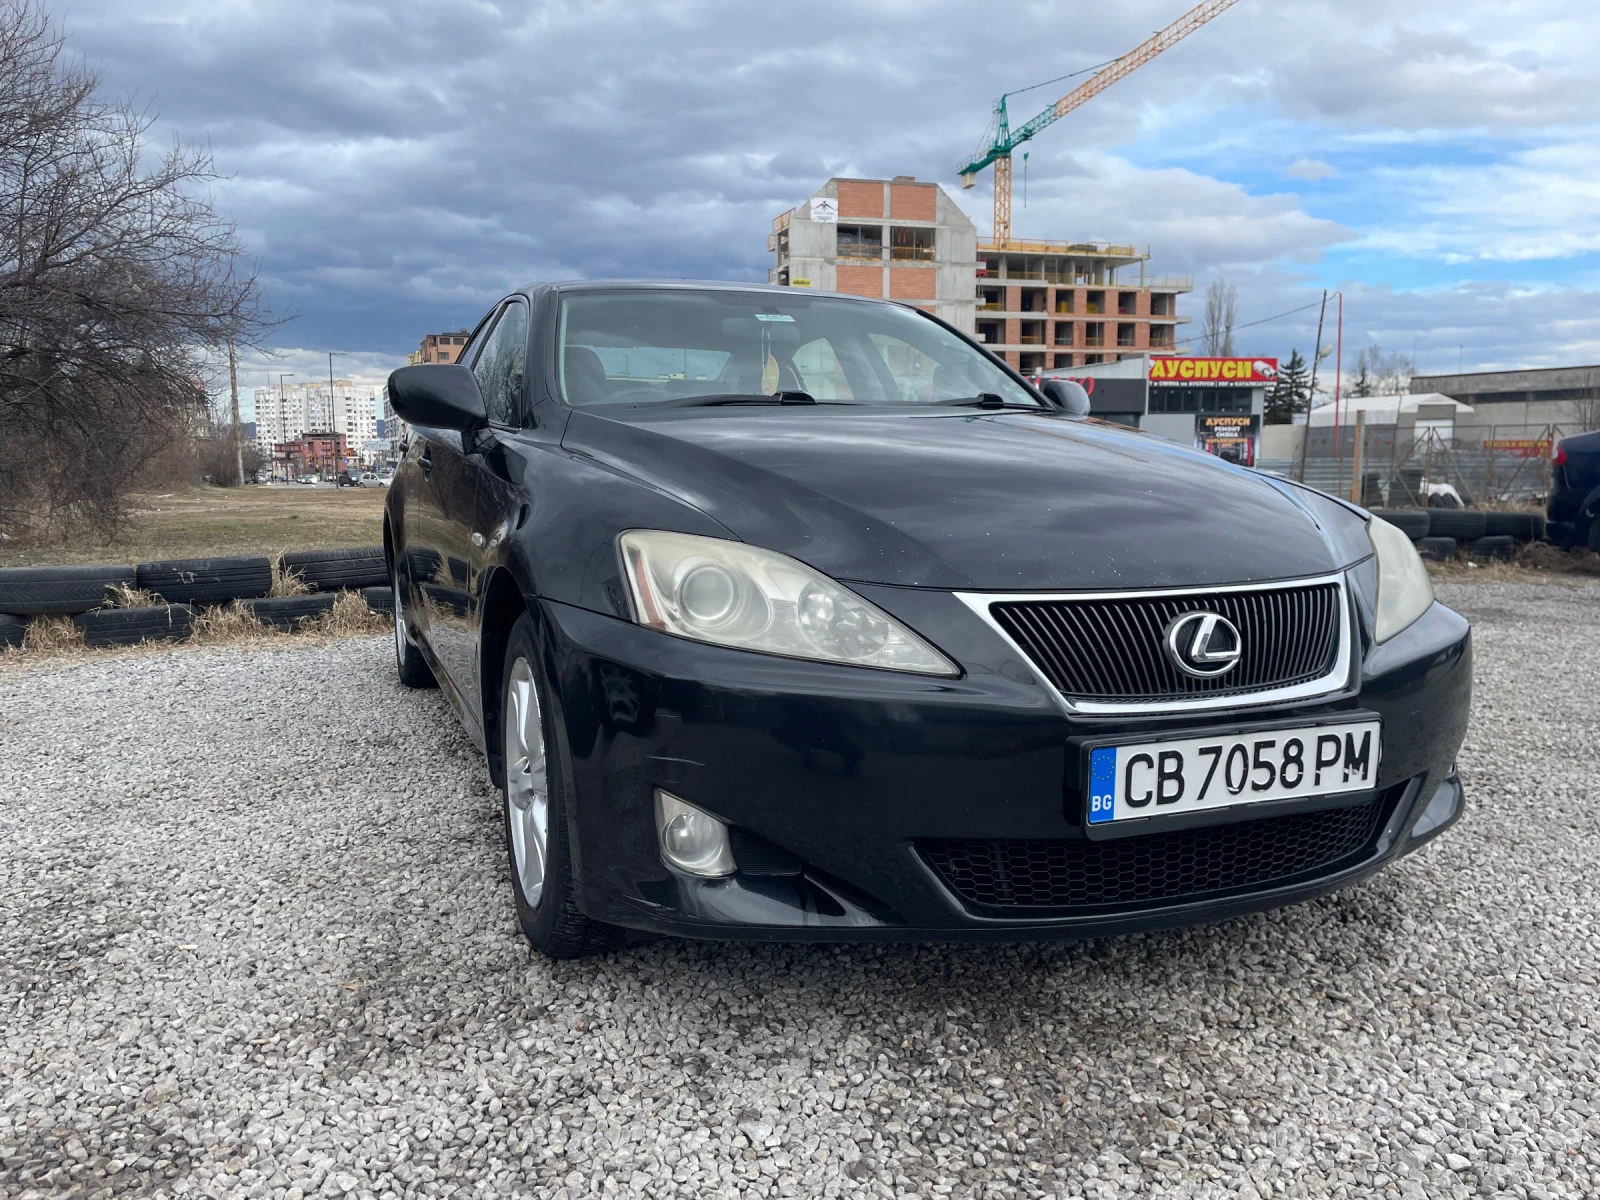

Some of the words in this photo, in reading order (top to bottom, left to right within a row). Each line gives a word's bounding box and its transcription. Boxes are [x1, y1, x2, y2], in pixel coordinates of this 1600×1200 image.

[1151, 359, 1252, 379] АУСПУСИ
[1205, 417, 1251, 426] АУСПУСИ
[1124, 750, 1186, 808] CB
[1196, 737, 1305, 801] 7058
[1314, 730, 1373, 787] PM
[1091, 794, 1113, 812] BG
